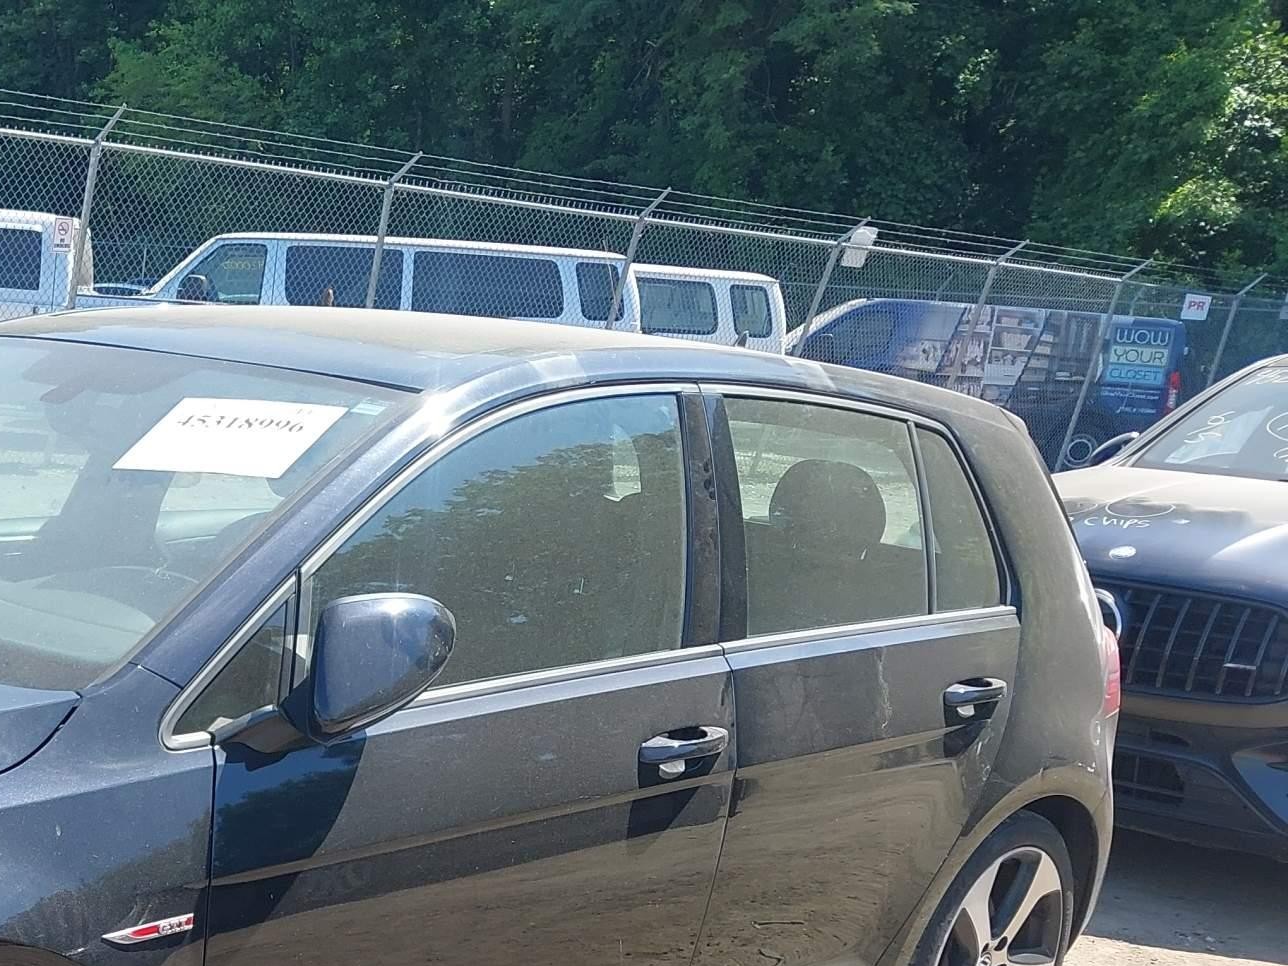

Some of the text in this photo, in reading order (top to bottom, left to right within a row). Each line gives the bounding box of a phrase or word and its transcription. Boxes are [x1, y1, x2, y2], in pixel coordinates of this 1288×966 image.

[1187, 300, 1207, 311] PR
[1116, 328, 1169, 346] WOW
[1114, 348, 1165, 364] YOUR
[1109, 367, 1161, 382] CLOSET
